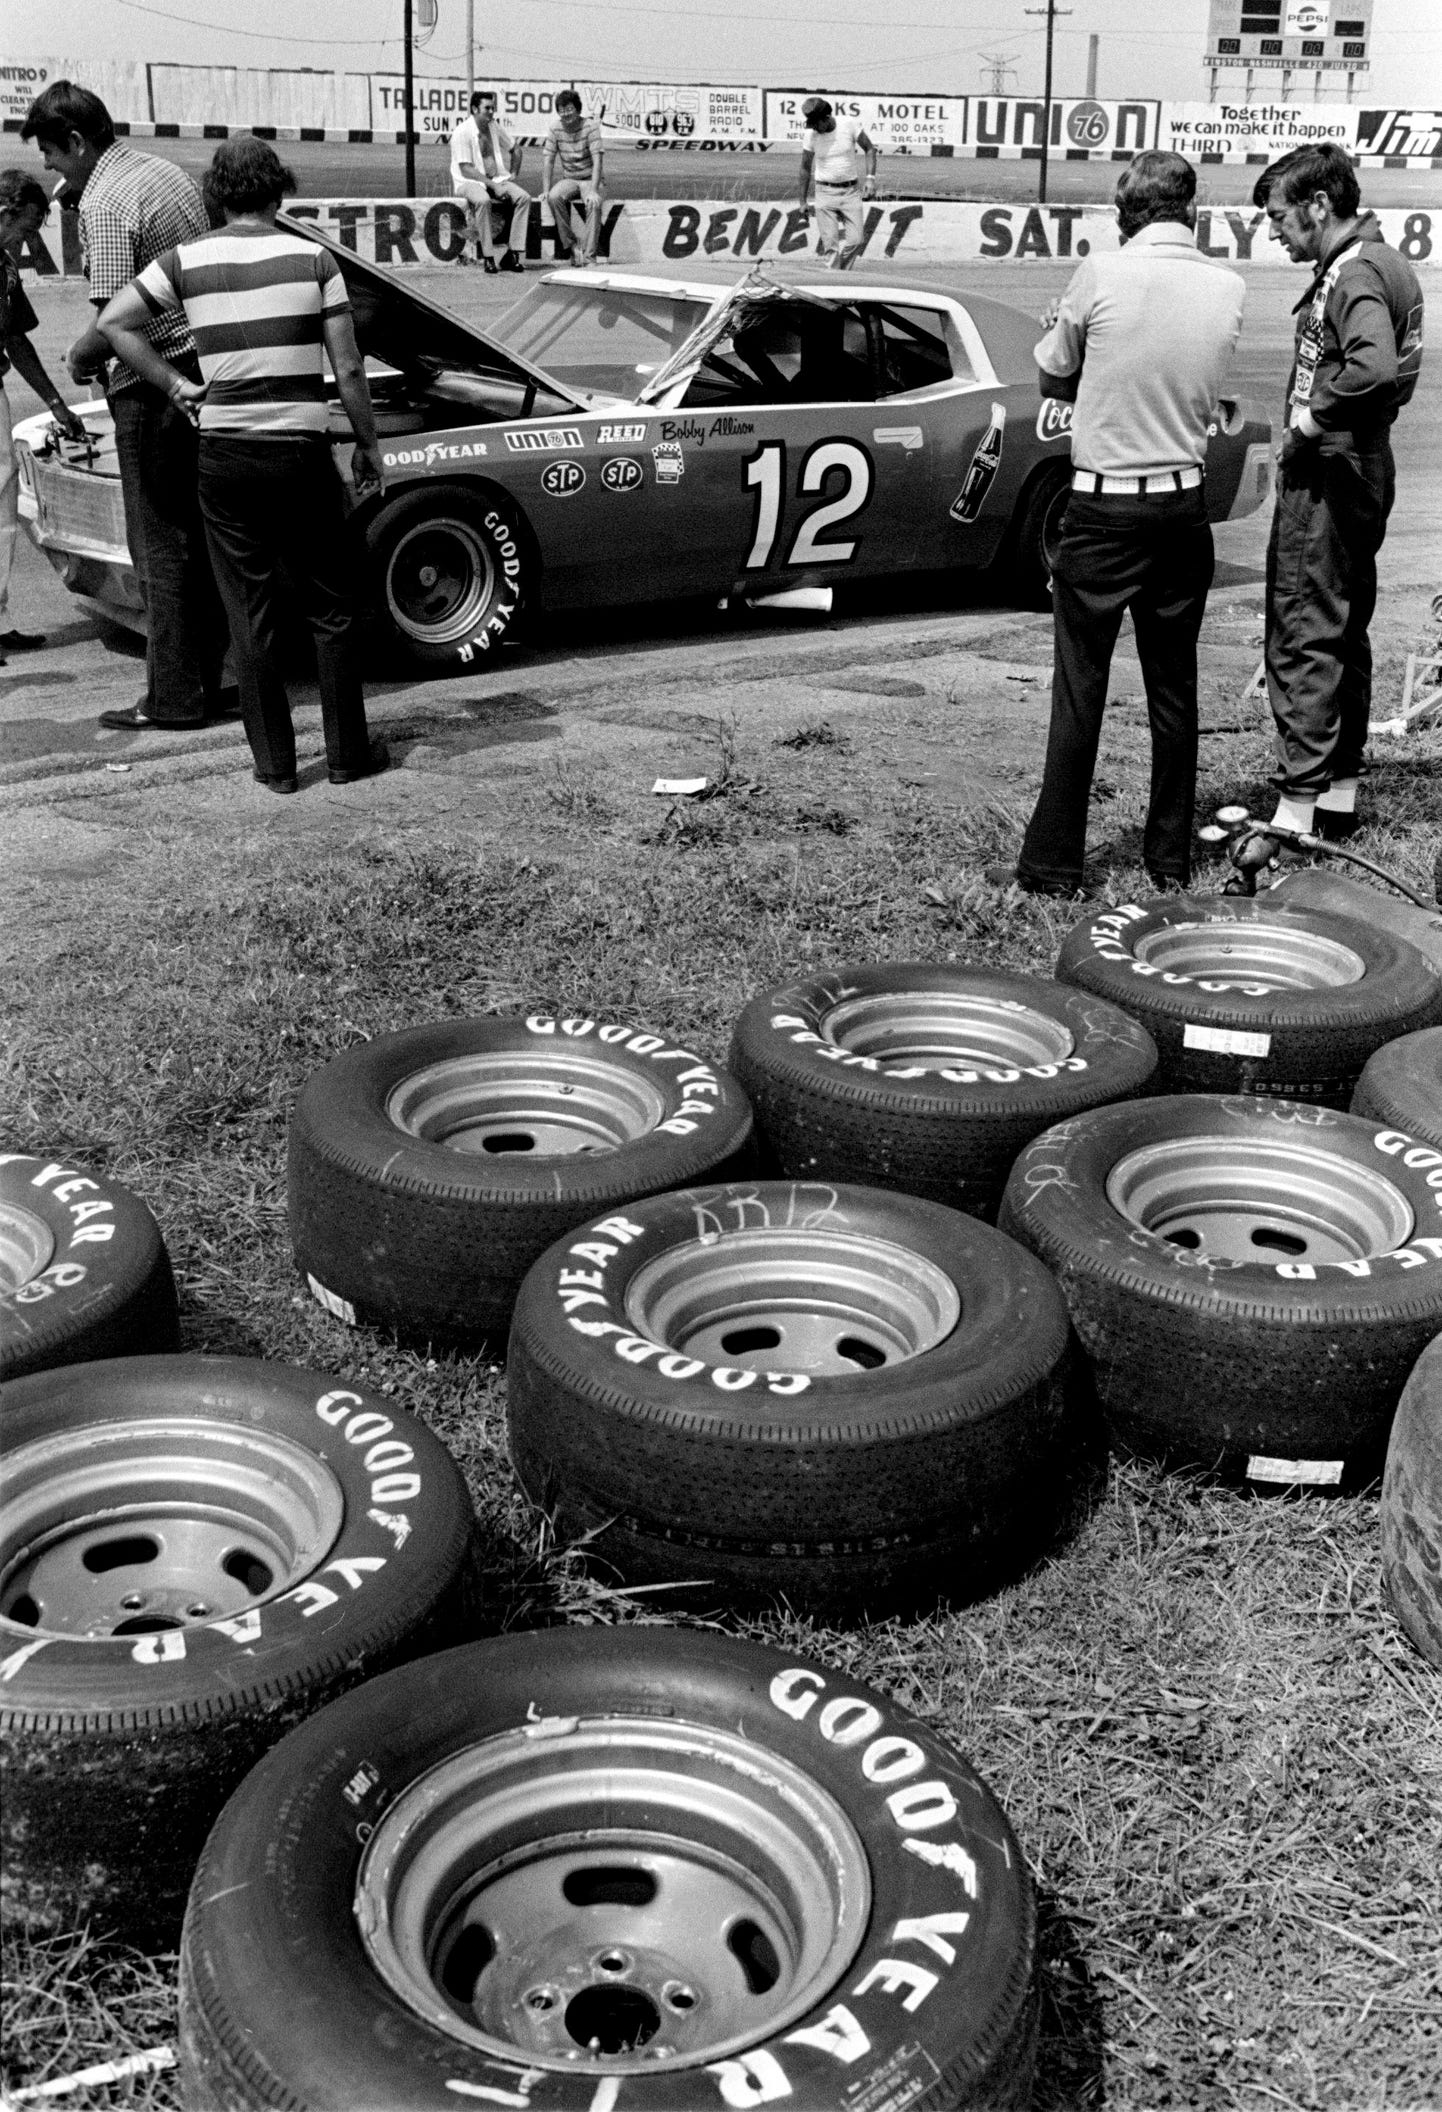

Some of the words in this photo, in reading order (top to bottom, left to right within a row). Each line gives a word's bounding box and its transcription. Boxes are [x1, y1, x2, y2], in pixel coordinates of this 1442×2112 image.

[1288, 14, 1328, 23] PEPSI
[39, 68, 47, 82] 9
[1250, 59, 1300, 69] NASHVILLE
[1306, 61, 1323, 69] 420
[584, 86, 700, 115] WMTS
[709, 92, 747, 104] DOUBLE
[709, 104, 750, 115] BARREL
[780, 100, 796, 115] 12
[877, 104, 949, 120] MOTEL
[709, 116, 743, 126] RADIO
[1220, 105, 1301, 121] Together
[871, 122, 885, 132] AT
[891, 123, 909, 133] 100
[914, 123, 944, 134] OAKS
[1073, 114, 1105, 140] 76
[1170, 121, 1190, 133] we
[1194, 122, 1222, 134] can
[1225, 121, 1269, 136] make
[1273, 122, 1285, 136] it
[1288, 122, 1346, 139] happen
[1355, 111, 1442, 155] Jim
[635, 138, 774, 152] SPEEDWAY
[1168, 138, 1232, 153] THIRD
[979, 207, 1090, 258] SAT.
[1399, 212, 1433, 261] 8
[597, 424, 647, 444] REED
[660, 419, 705, 447] Bobby
[709, 416, 755, 438] Allison
[383, 442, 487, 466] OODYEAR
[547, 463, 580, 489] STP
[606, 461, 638, 485] STP
[742, 437, 875, 570] 12
[457, 511, 524, 663] GOODYEAR
[525, 1015, 719, 1136] GOODYEAR
[557, 1215, 812, 1395] GOODYEAR
[131, 1390, 422, 1665] GOODYEAR
[706, 1667, 978, 2110] GOODYEAR
